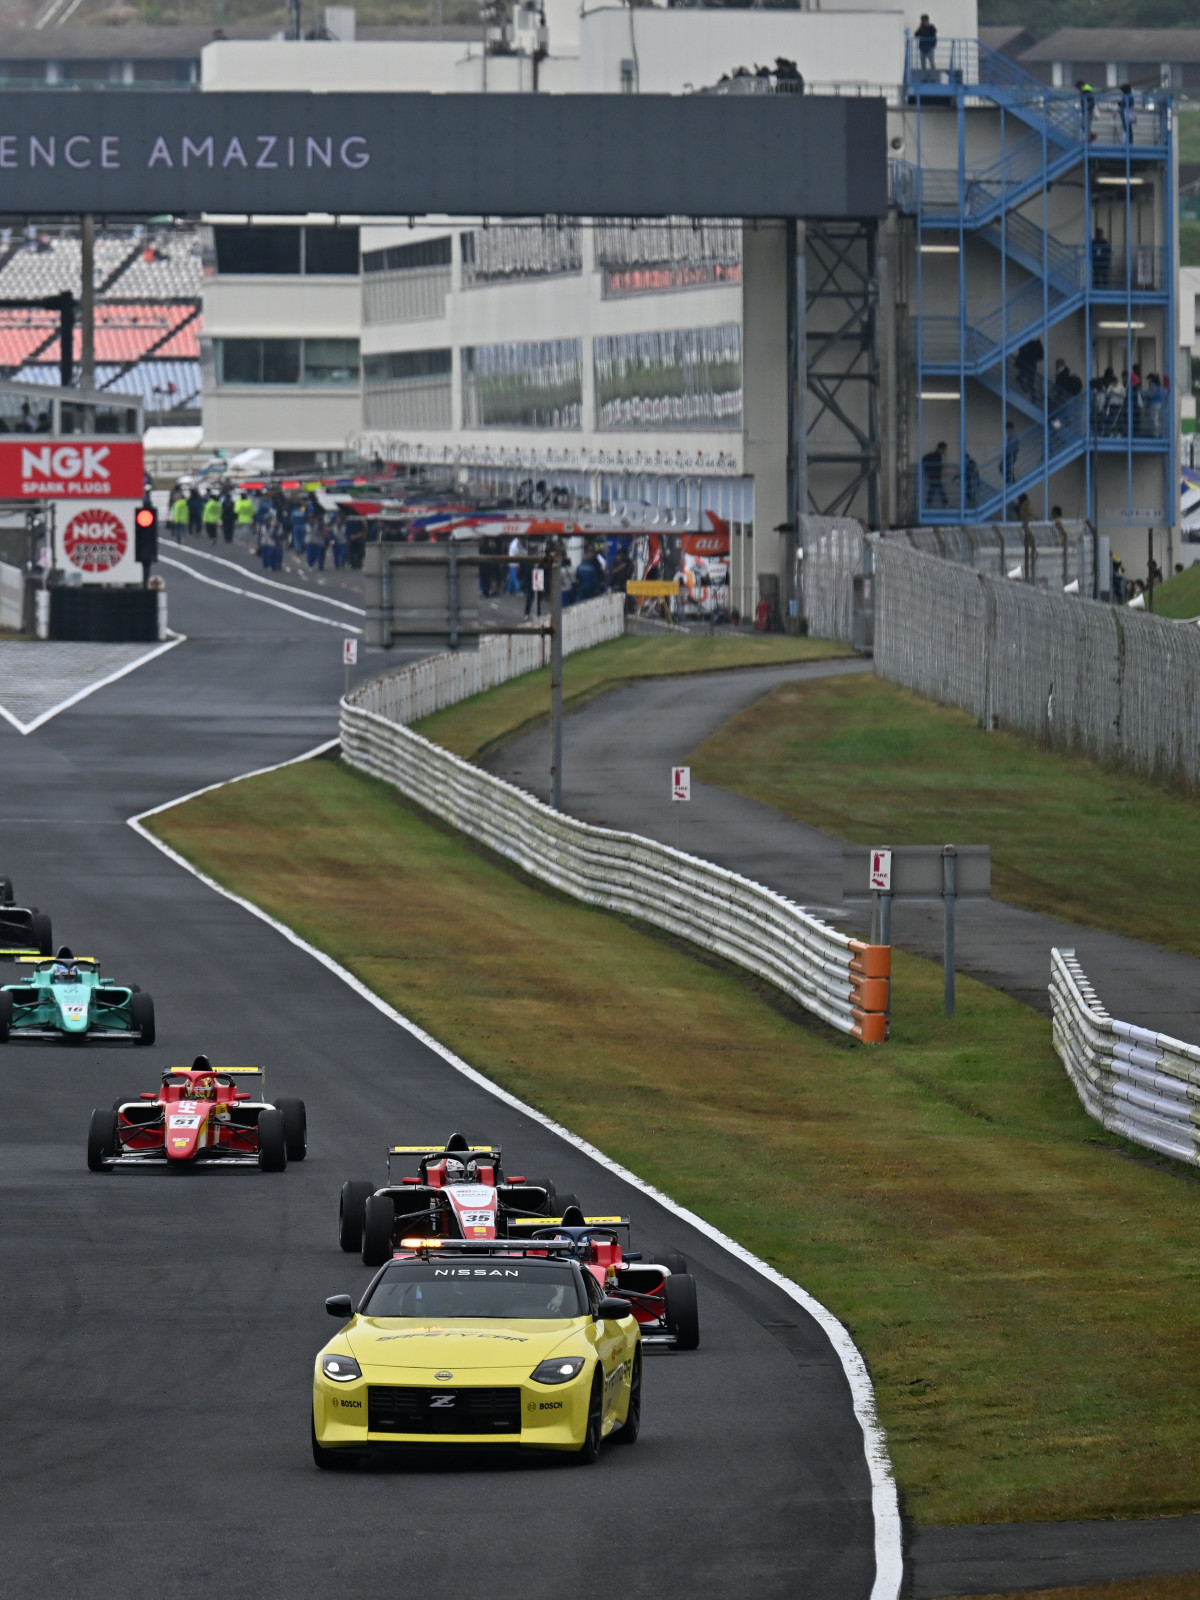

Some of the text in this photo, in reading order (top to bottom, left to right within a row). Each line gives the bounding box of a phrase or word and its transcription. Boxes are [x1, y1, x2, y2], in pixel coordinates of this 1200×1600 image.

[147, 135, 372, 169] AMAZING
[21, 446, 111, 479] NGK
[22, 482, 111, 494] SPARK PLUGS
[73, 522, 117, 539] NGK
[465, 1214, 491, 1223] 35
[434, 1269, 519, 1277] NISSAN
[341, 1399, 362, 1409] BOSCH
[539, 1402, 563, 1410] BOSCH
